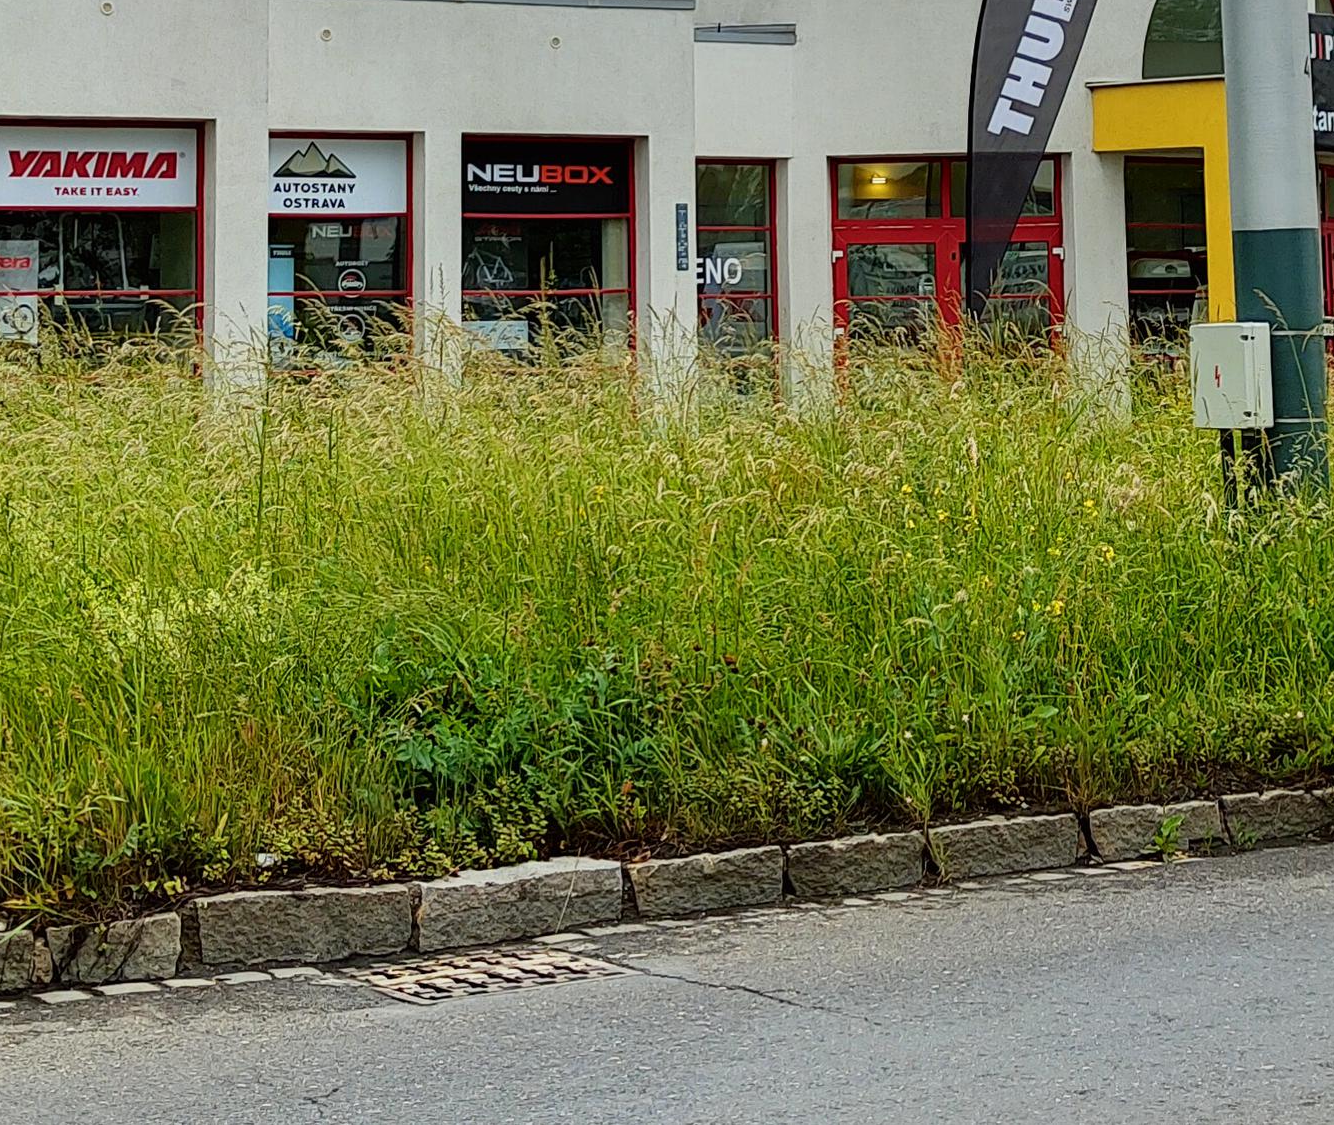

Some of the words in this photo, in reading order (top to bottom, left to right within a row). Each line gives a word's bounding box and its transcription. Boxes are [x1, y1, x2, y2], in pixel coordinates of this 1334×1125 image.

[8, 150, 178, 179] YAKIMA
[467, 163, 614, 184] NEUBOX
[55, 187, 87, 196] TAKE
[91, 187, 103, 196] IT
[273, 182, 356, 194] AUTOSTANY
[283, 198, 346, 209] OSTRAVA
